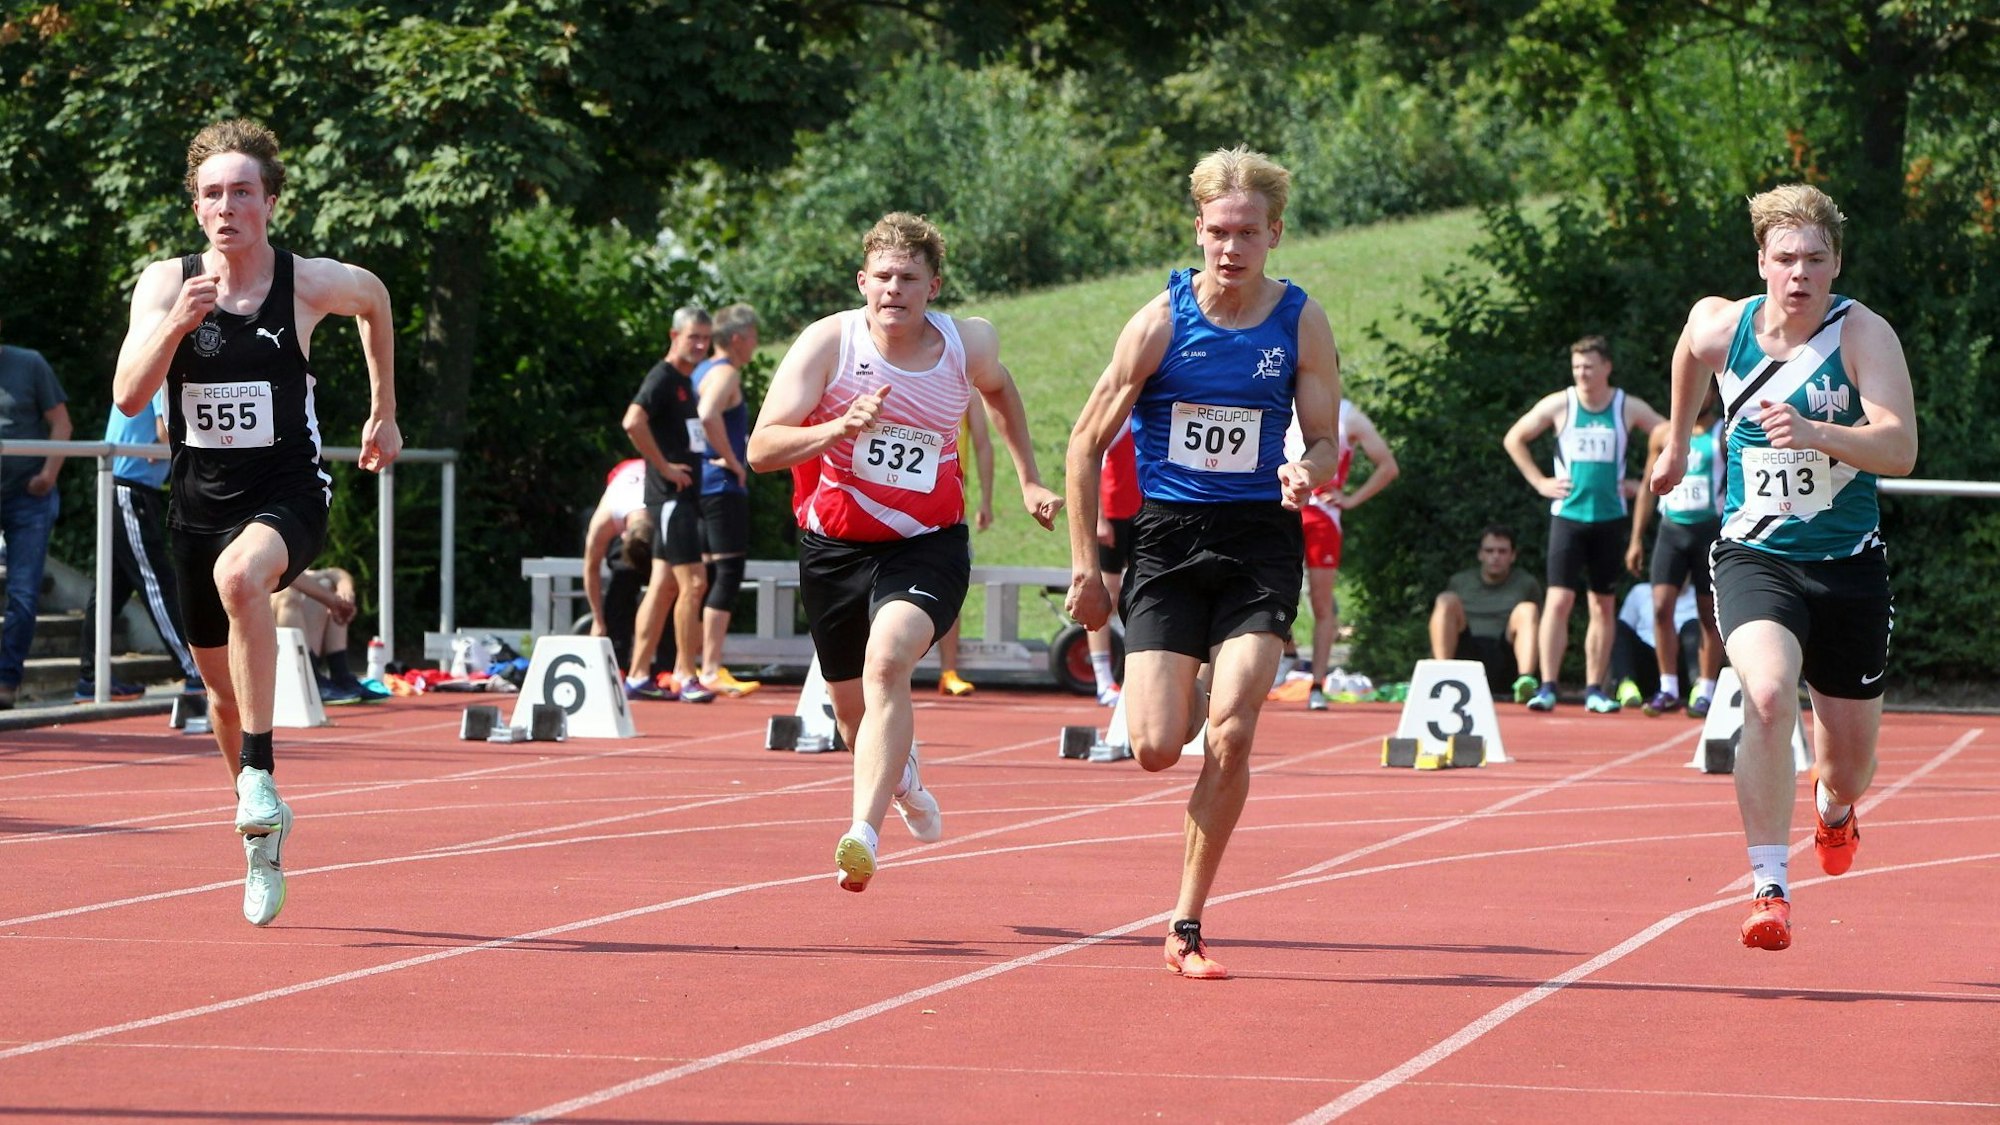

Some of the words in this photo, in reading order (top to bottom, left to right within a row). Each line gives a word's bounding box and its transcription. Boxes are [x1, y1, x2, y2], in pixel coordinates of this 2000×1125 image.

[203, 385, 267, 399] REGUPOL
[196, 402, 257, 431] 555
[1197, 407, 1256, 422] REGUPOL
[881, 425, 937, 446] REGUPOL
[1184, 421, 1246, 455] 509
[1578, 438, 1607, 452] 211
[867, 438, 925, 474] 532
[1762, 451, 1823, 464] REGUPOL
[1674, 487, 1701, 501] 18
[1756, 468, 1815, 497] 213
[543, 653, 587, 716] 6
[1426, 679, 1474, 742] 3
